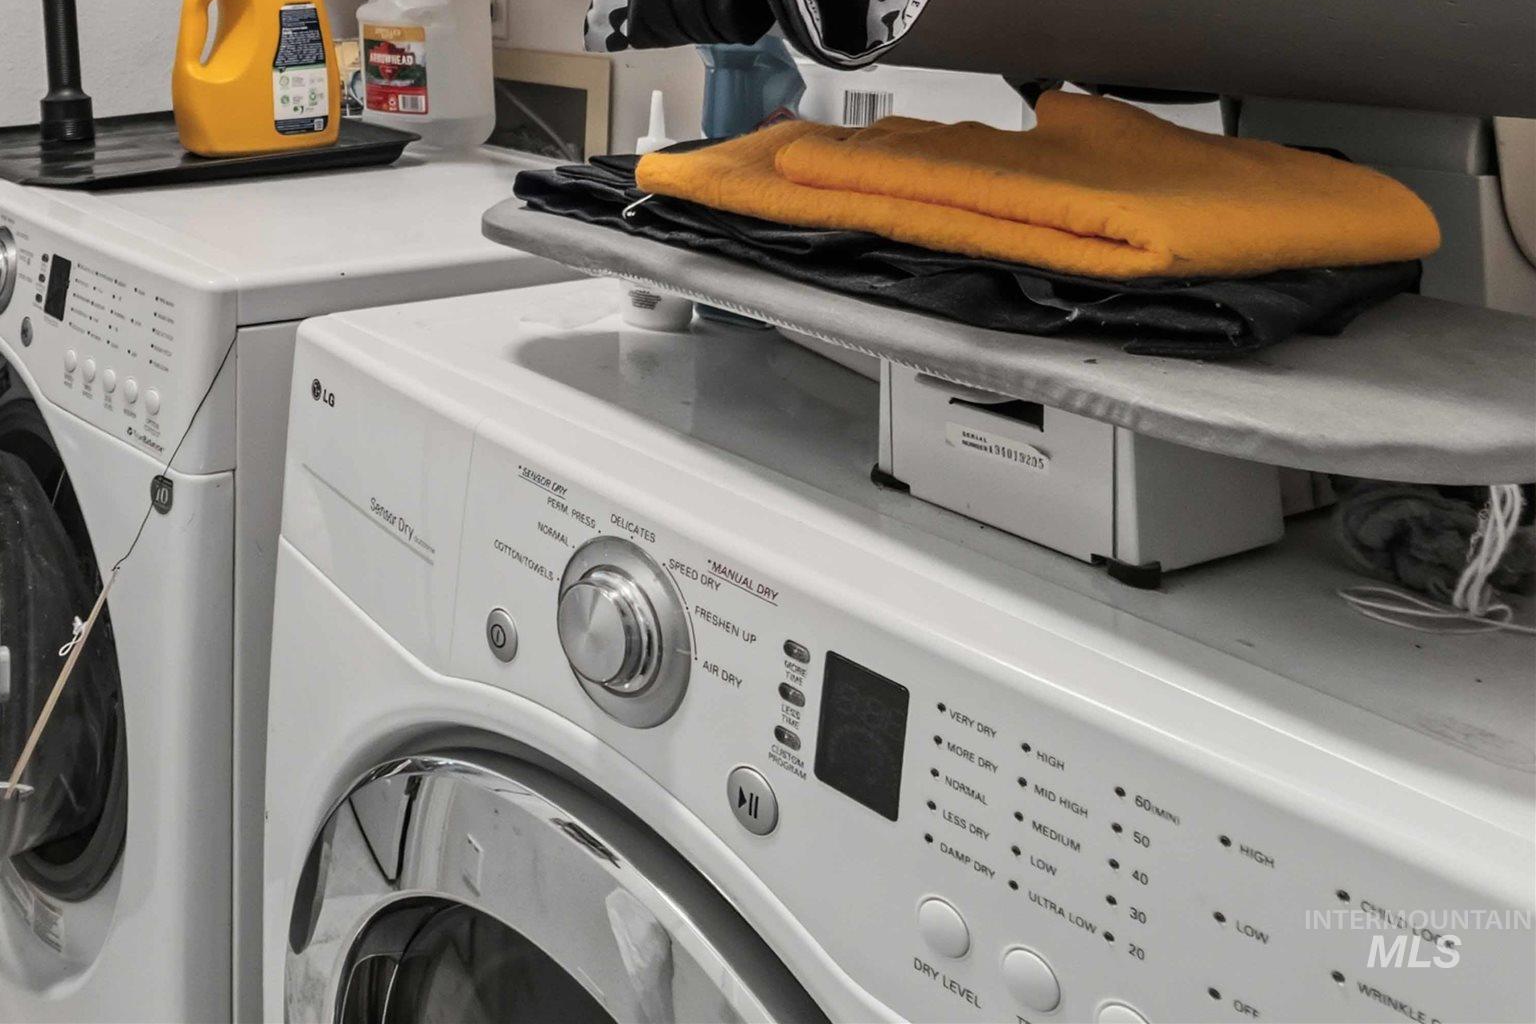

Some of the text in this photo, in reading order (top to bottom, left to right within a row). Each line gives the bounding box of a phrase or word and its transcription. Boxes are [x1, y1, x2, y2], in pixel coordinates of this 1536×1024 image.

[322, 388, 335, 407] LG
[962, 431, 987, 443] SERIAL
[521, 467, 551, 488] SENSOR
[370, 497, 414, 542] Sensor Dry
[571, 508, 596, 529] PRESS
[610, 513, 656, 544] DELICATES
[537, 521, 570, 547] NORMAL
[494, 539, 554, 582] COTTON/TOWELS
[668, 558, 722, 592] SPEED DRY
[711, 561, 779, 601] MANUAL DRY
[694, 605, 757, 644] FRESHEN UP
[702, 660, 743, 689] AIR DRY
[949, 709, 997, 738] VERY DRY
[947, 742, 999, 774] MORE DRY
[1036, 750, 1065, 771] HIGH
[945, 776, 989, 806] NORMAL
[1034, 784, 1088, 819] MID HIGH
[942, 809, 991, 841] LESS DRY
[1032, 820, 1081, 853] MEDIUM
[1133, 831, 1150, 848] 50
[940, 842, 996, 879] DAMP DRY
[1030, 855, 1057, 877] LOW
[1239, 844, 1275, 869] HIGH
[1131, 869, 1149, 886] 40
[1028, 890, 1097, 935] ULTRA LOW
[1129, 906, 1147, 925] 30
[1235, 919, 1269, 945] LOW
[1128, 943, 1145, 961] 20
[913, 957, 983, 1010] DRY LEVEL
[1233, 998, 1260, 1020] OFF
[1357, 981, 1427, 1024] WRINKLE
